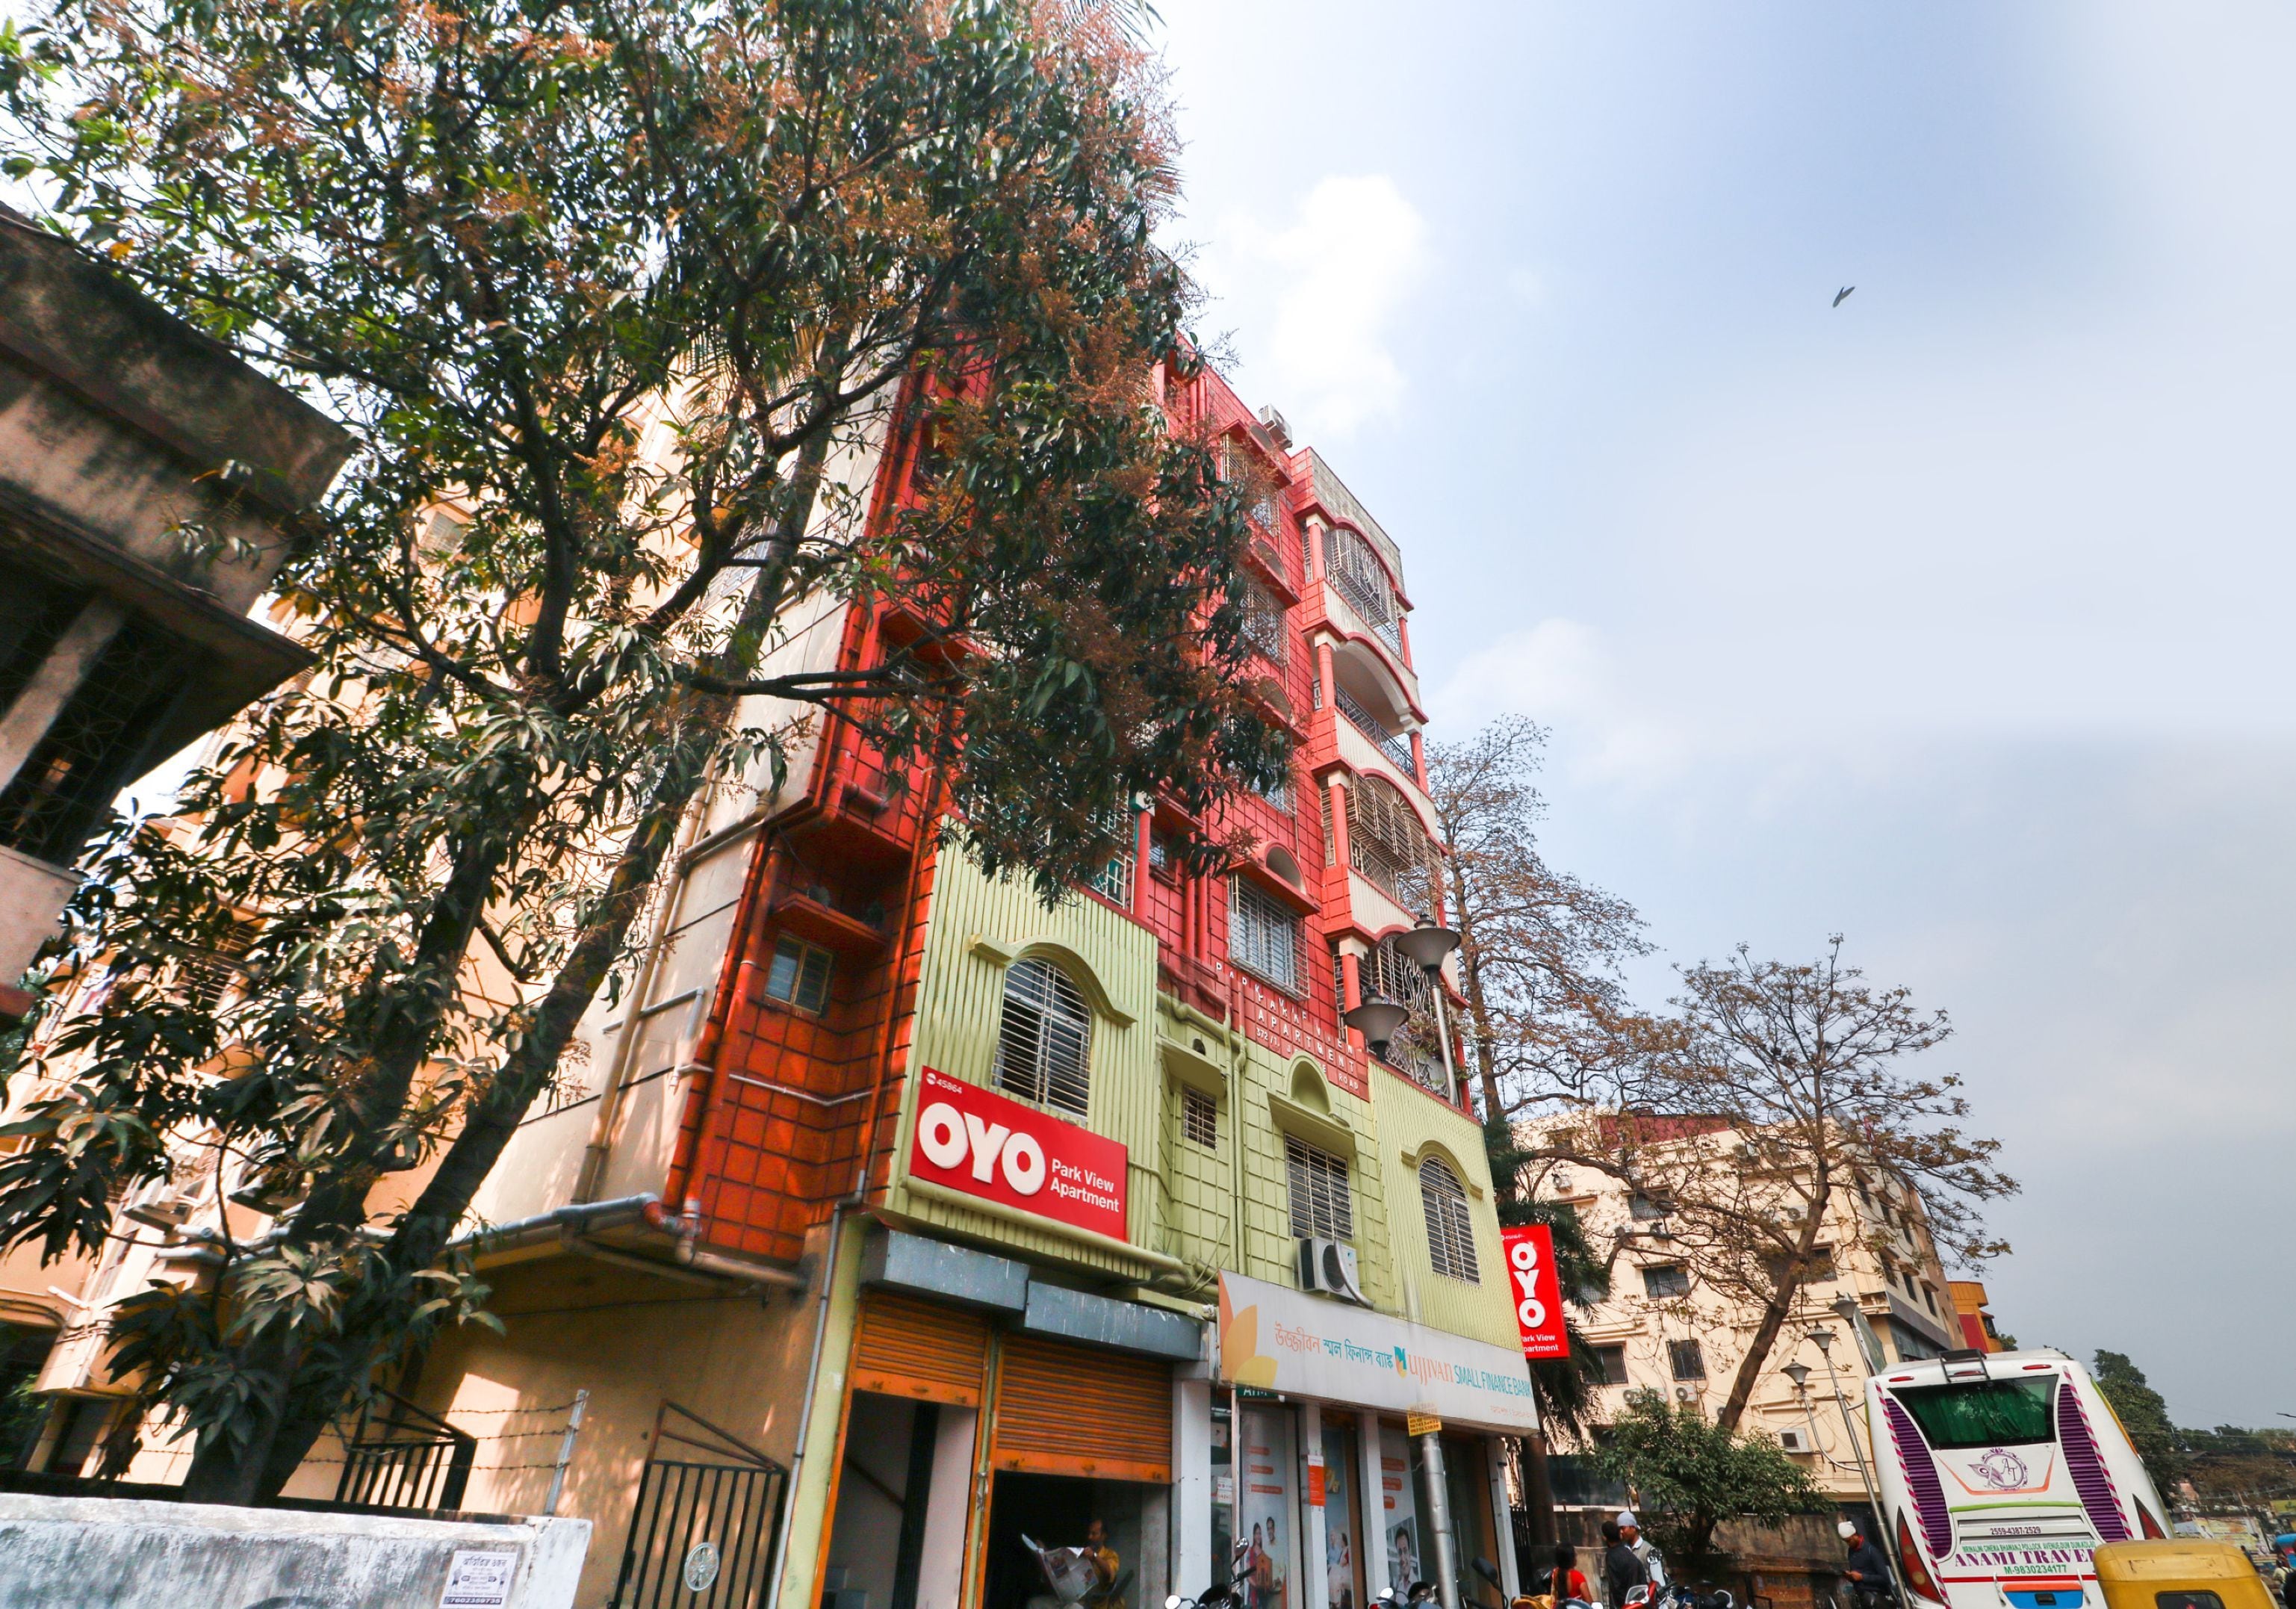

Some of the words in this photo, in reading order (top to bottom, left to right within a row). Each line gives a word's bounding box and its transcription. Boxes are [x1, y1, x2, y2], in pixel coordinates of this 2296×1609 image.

[919, 1102, 1046, 1196] OYO
[1052, 1158, 1082, 1182] Park
[1084, 1169, 1114, 1193] View
[1050, 1176, 1120, 1212] Apartment
[1511, 1242, 1546, 1328] OYO
[1274, 1321, 1321, 1354] উজ্জীবন
[1521, 1334, 1535, 1342] ark
[1523, 1344, 1559, 1352] partment
[1454, 1365, 1482, 1389] SMALL
[1481, 1371, 1513, 1395] FINANCE
[1955, 1551, 2016, 1566] ANAMI
[2004, 1565, 2067, 1574] M-9830234177
